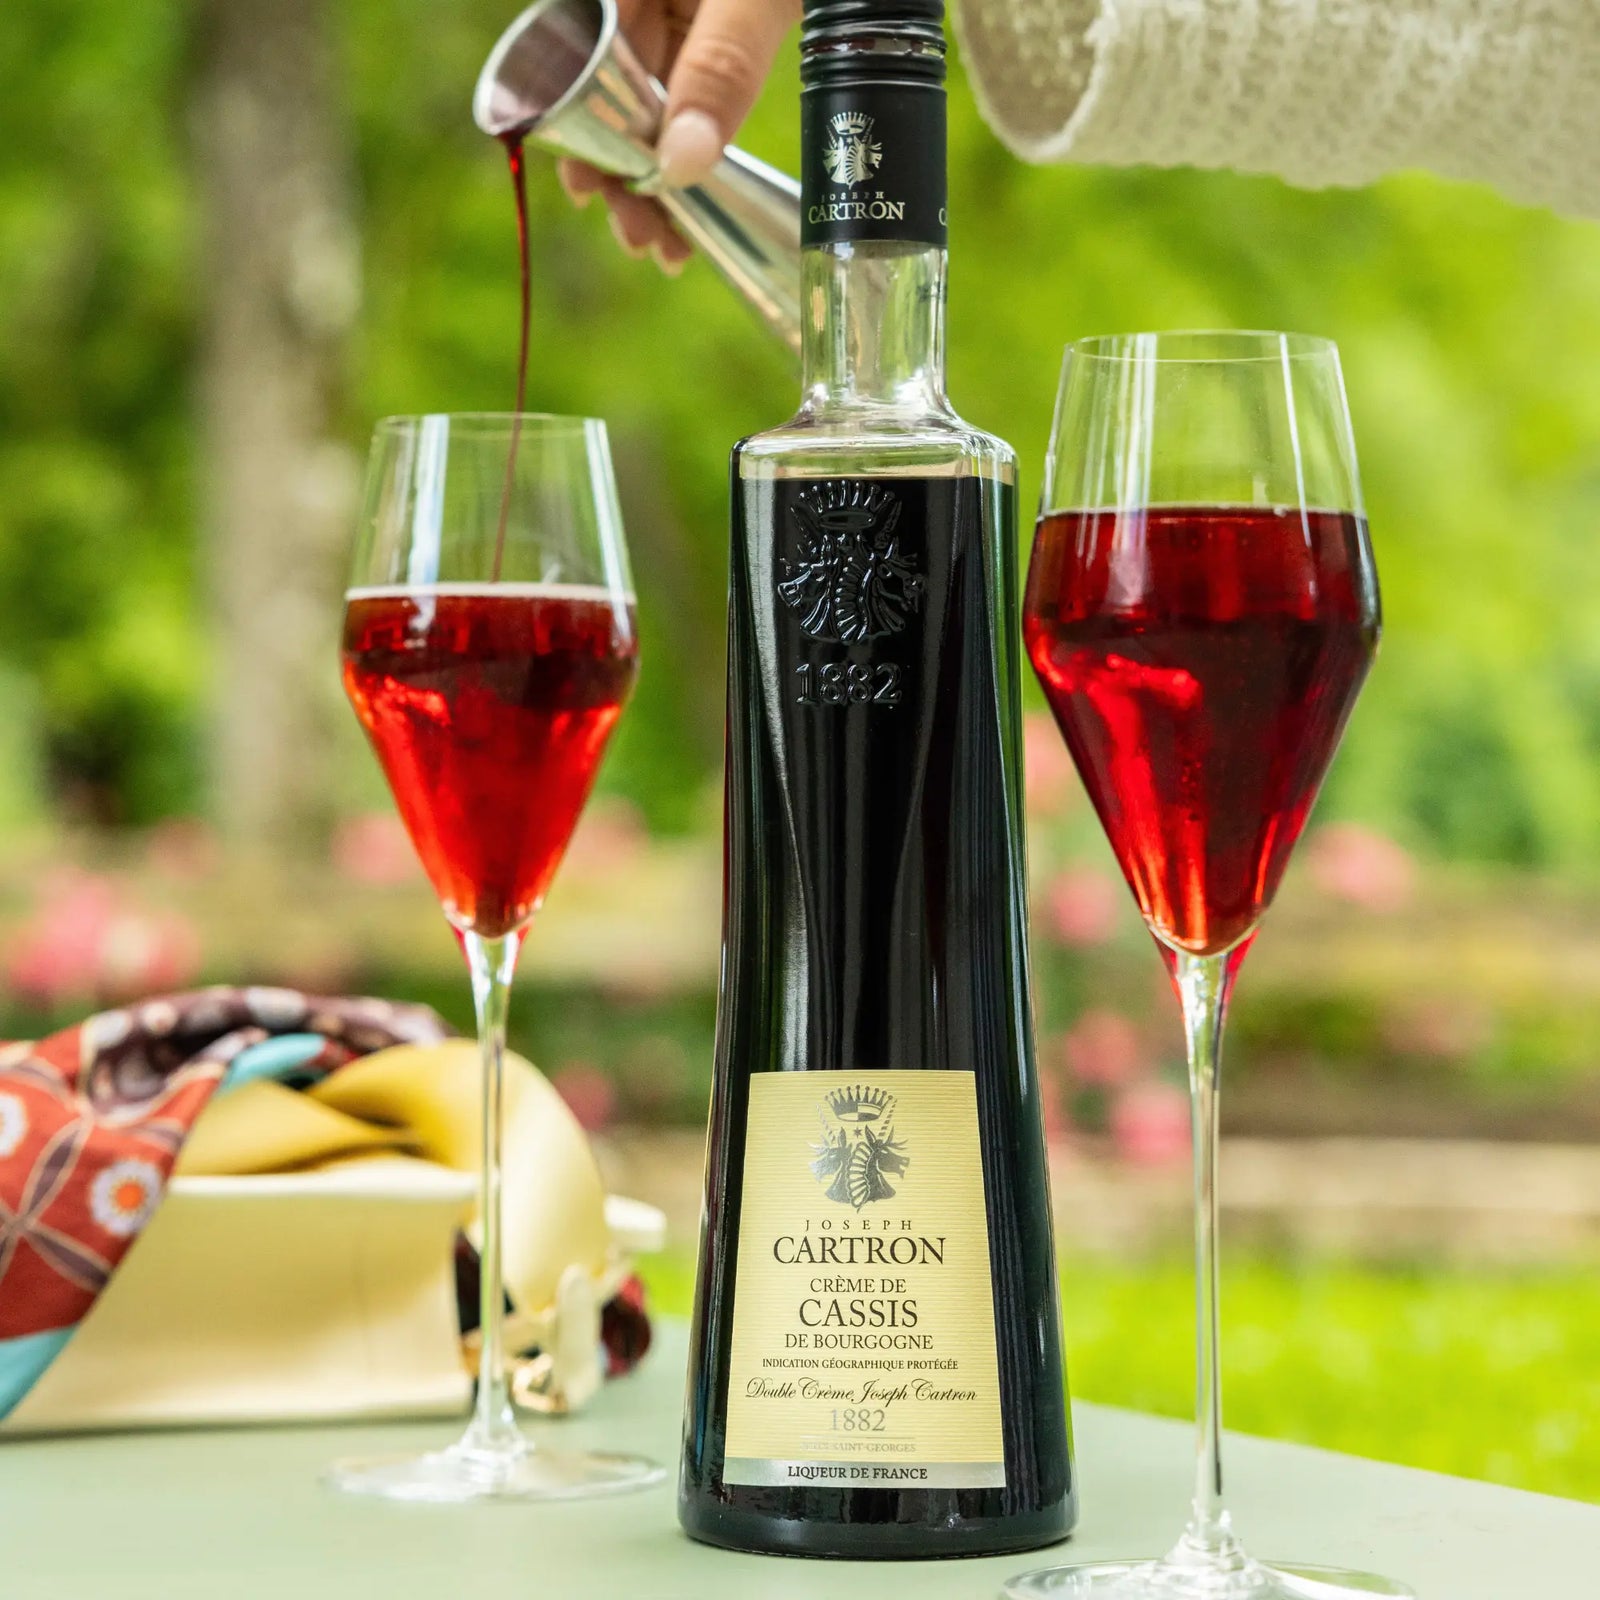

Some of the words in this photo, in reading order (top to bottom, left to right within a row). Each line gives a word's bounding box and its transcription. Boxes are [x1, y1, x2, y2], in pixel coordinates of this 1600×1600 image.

[821, 191, 885, 203] JOSEPH
[808, 201, 906, 225] CARTRON
[796, 663, 902, 705] 1882
[806, 1219, 912, 1232] JOSEPH
[773, 1236, 946, 1265] CARTRON
[809, 1275, 875, 1293] CRÈME
[881, 1278, 907, 1293] DE
[799, 1299, 918, 1327] CASSIS
[784, 1333, 808, 1348] DE
[813, 1334, 933, 1350] BOURGOGNE
[762, 1358, 819, 1369] INDICATION
[821, 1357, 905, 1372] GÉOGRAPHIQUE
[907, 1358, 959, 1370] PROTÉGÉE
[745, 1376, 797, 1399] Double
[851, 1378, 909, 1407] Joseph
[911, 1378, 977, 1401] Cartron
[830, 1408, 886, 1432] 1882
[787, 1466, 847, 1480] LIQUEUR
[850, 1467, 870, 1479] DE
[872, 1468, 928, 1480] FRANCE
